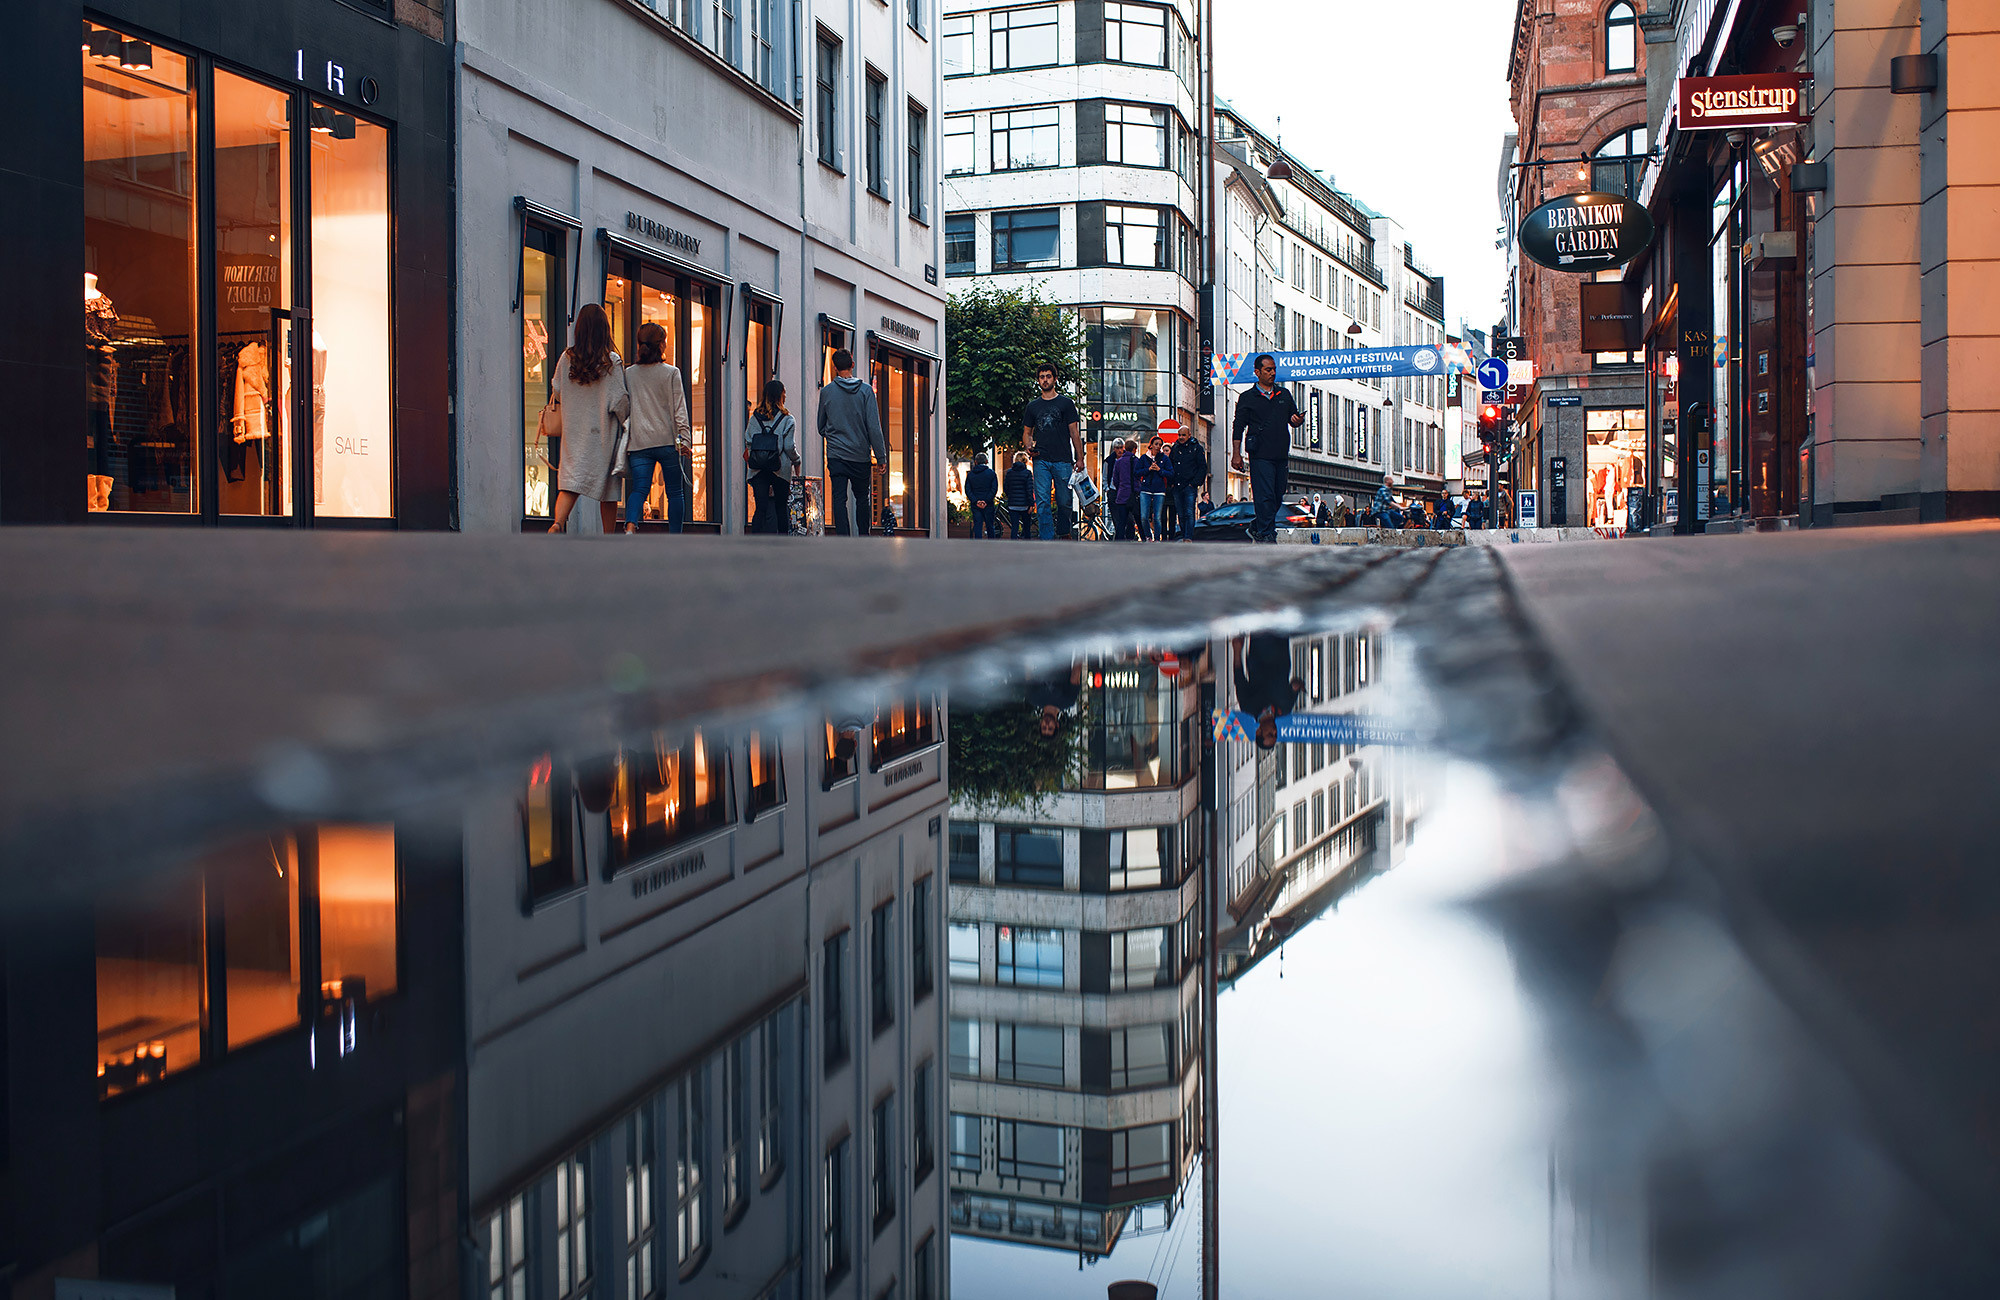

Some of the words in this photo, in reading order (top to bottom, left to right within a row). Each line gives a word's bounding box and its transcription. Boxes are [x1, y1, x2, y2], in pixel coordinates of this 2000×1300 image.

[297, 48, 379, 106] IRO
[1690, 84, 1797, 118] Stenstrup
[1547, 203, 1624, 229] BERNIKOW
[625, 210, 702, 256] BURBERRY
[1555, 226, 1619, 254] GÅRDEN
[881, 315, 921, 342] BURBERRY
[1684, 329, 1709, 342] KAS
[1203, 339, 1211, 396] COMPANYS
[1279, 353, 1353, 367] KULTURHAVN
[1354, 351, 1405, 364] FESTIVAL
[1290, 369, 1307, 377] 250
[1308, 367, 1340, 376] GRATIS
[1340, 364, 1393, 375] AKTIVITETER
[1506, 341, 1518, 400] TOOP
[1086, 410, 1138, 422] COMPANYS
[335, 436, 369, 456] SALE
